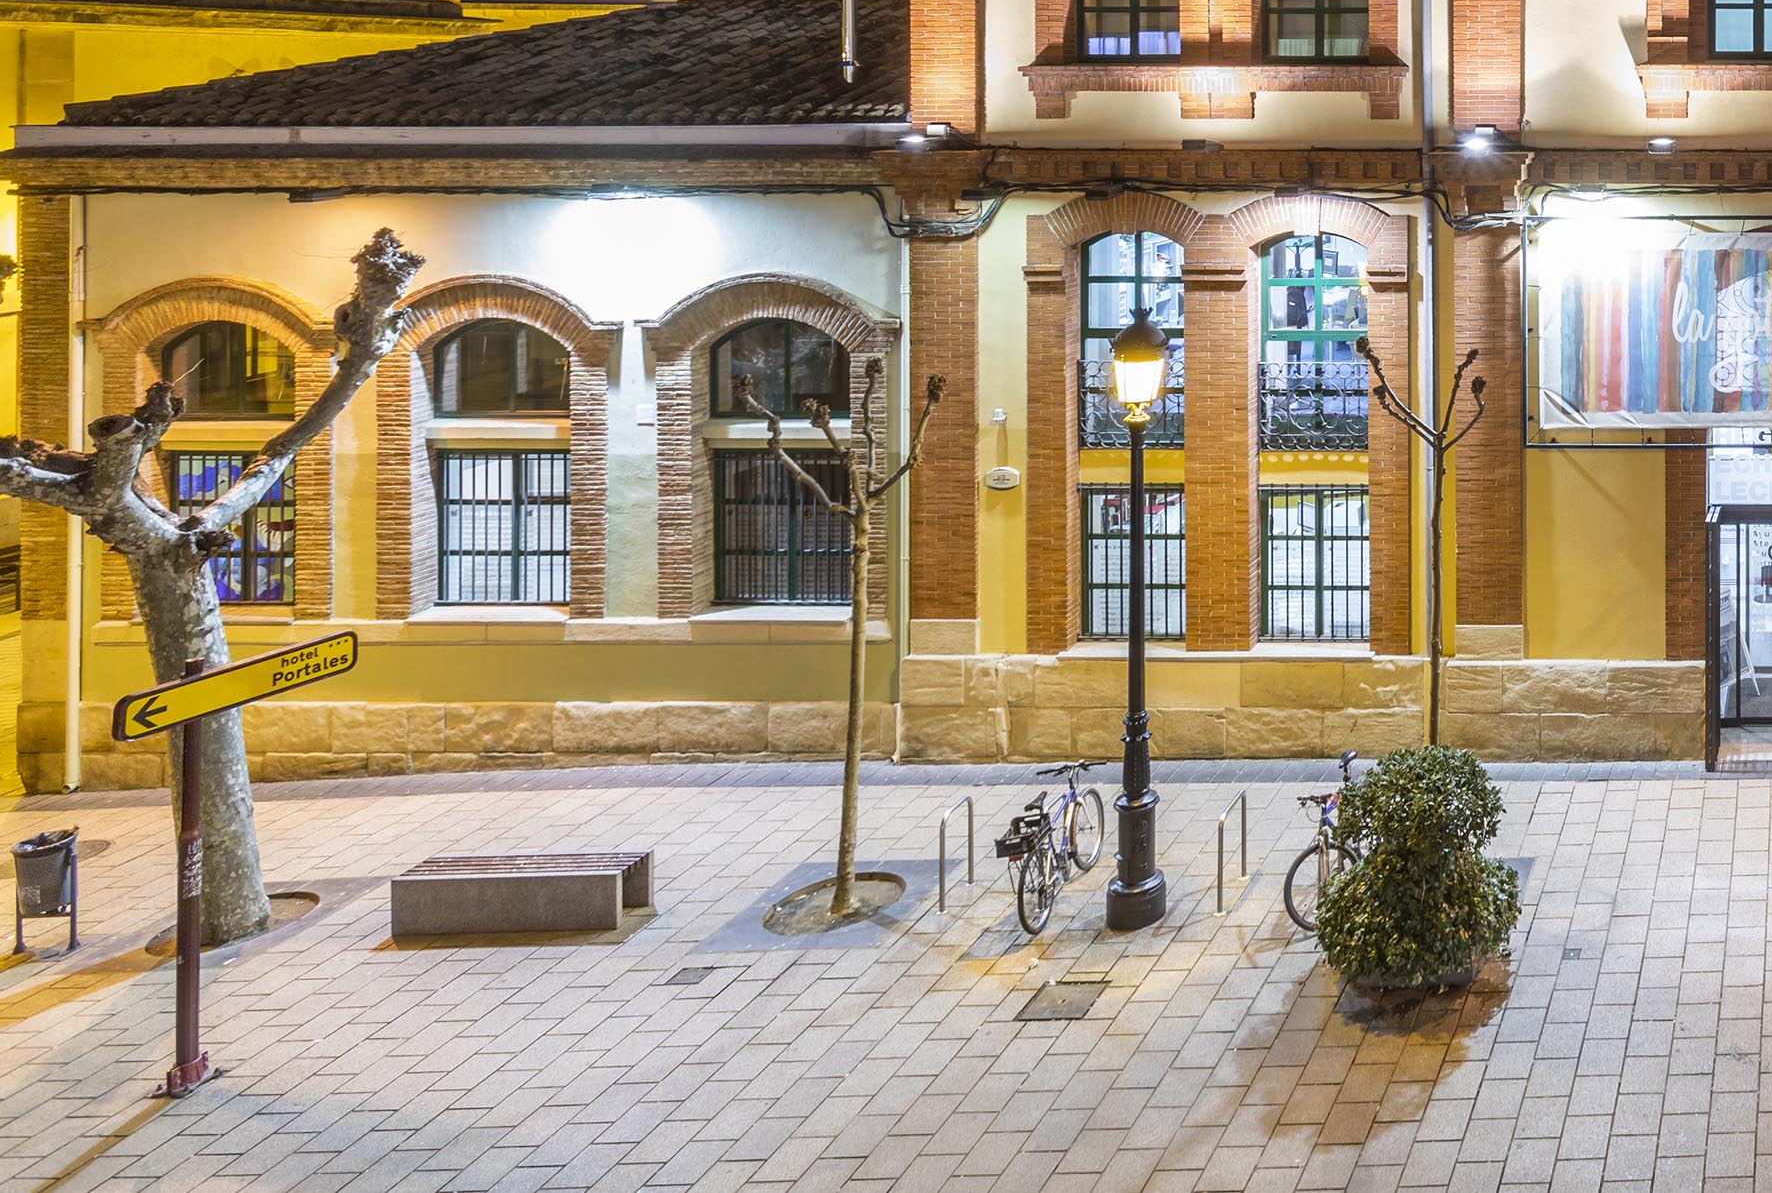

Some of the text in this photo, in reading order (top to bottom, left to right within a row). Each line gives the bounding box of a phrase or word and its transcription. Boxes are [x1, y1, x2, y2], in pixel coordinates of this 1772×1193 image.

[1672, 281, 1714, 343] la
[272, 654, 349, 687] Portales
[281, 647, 318, 667] hotel
